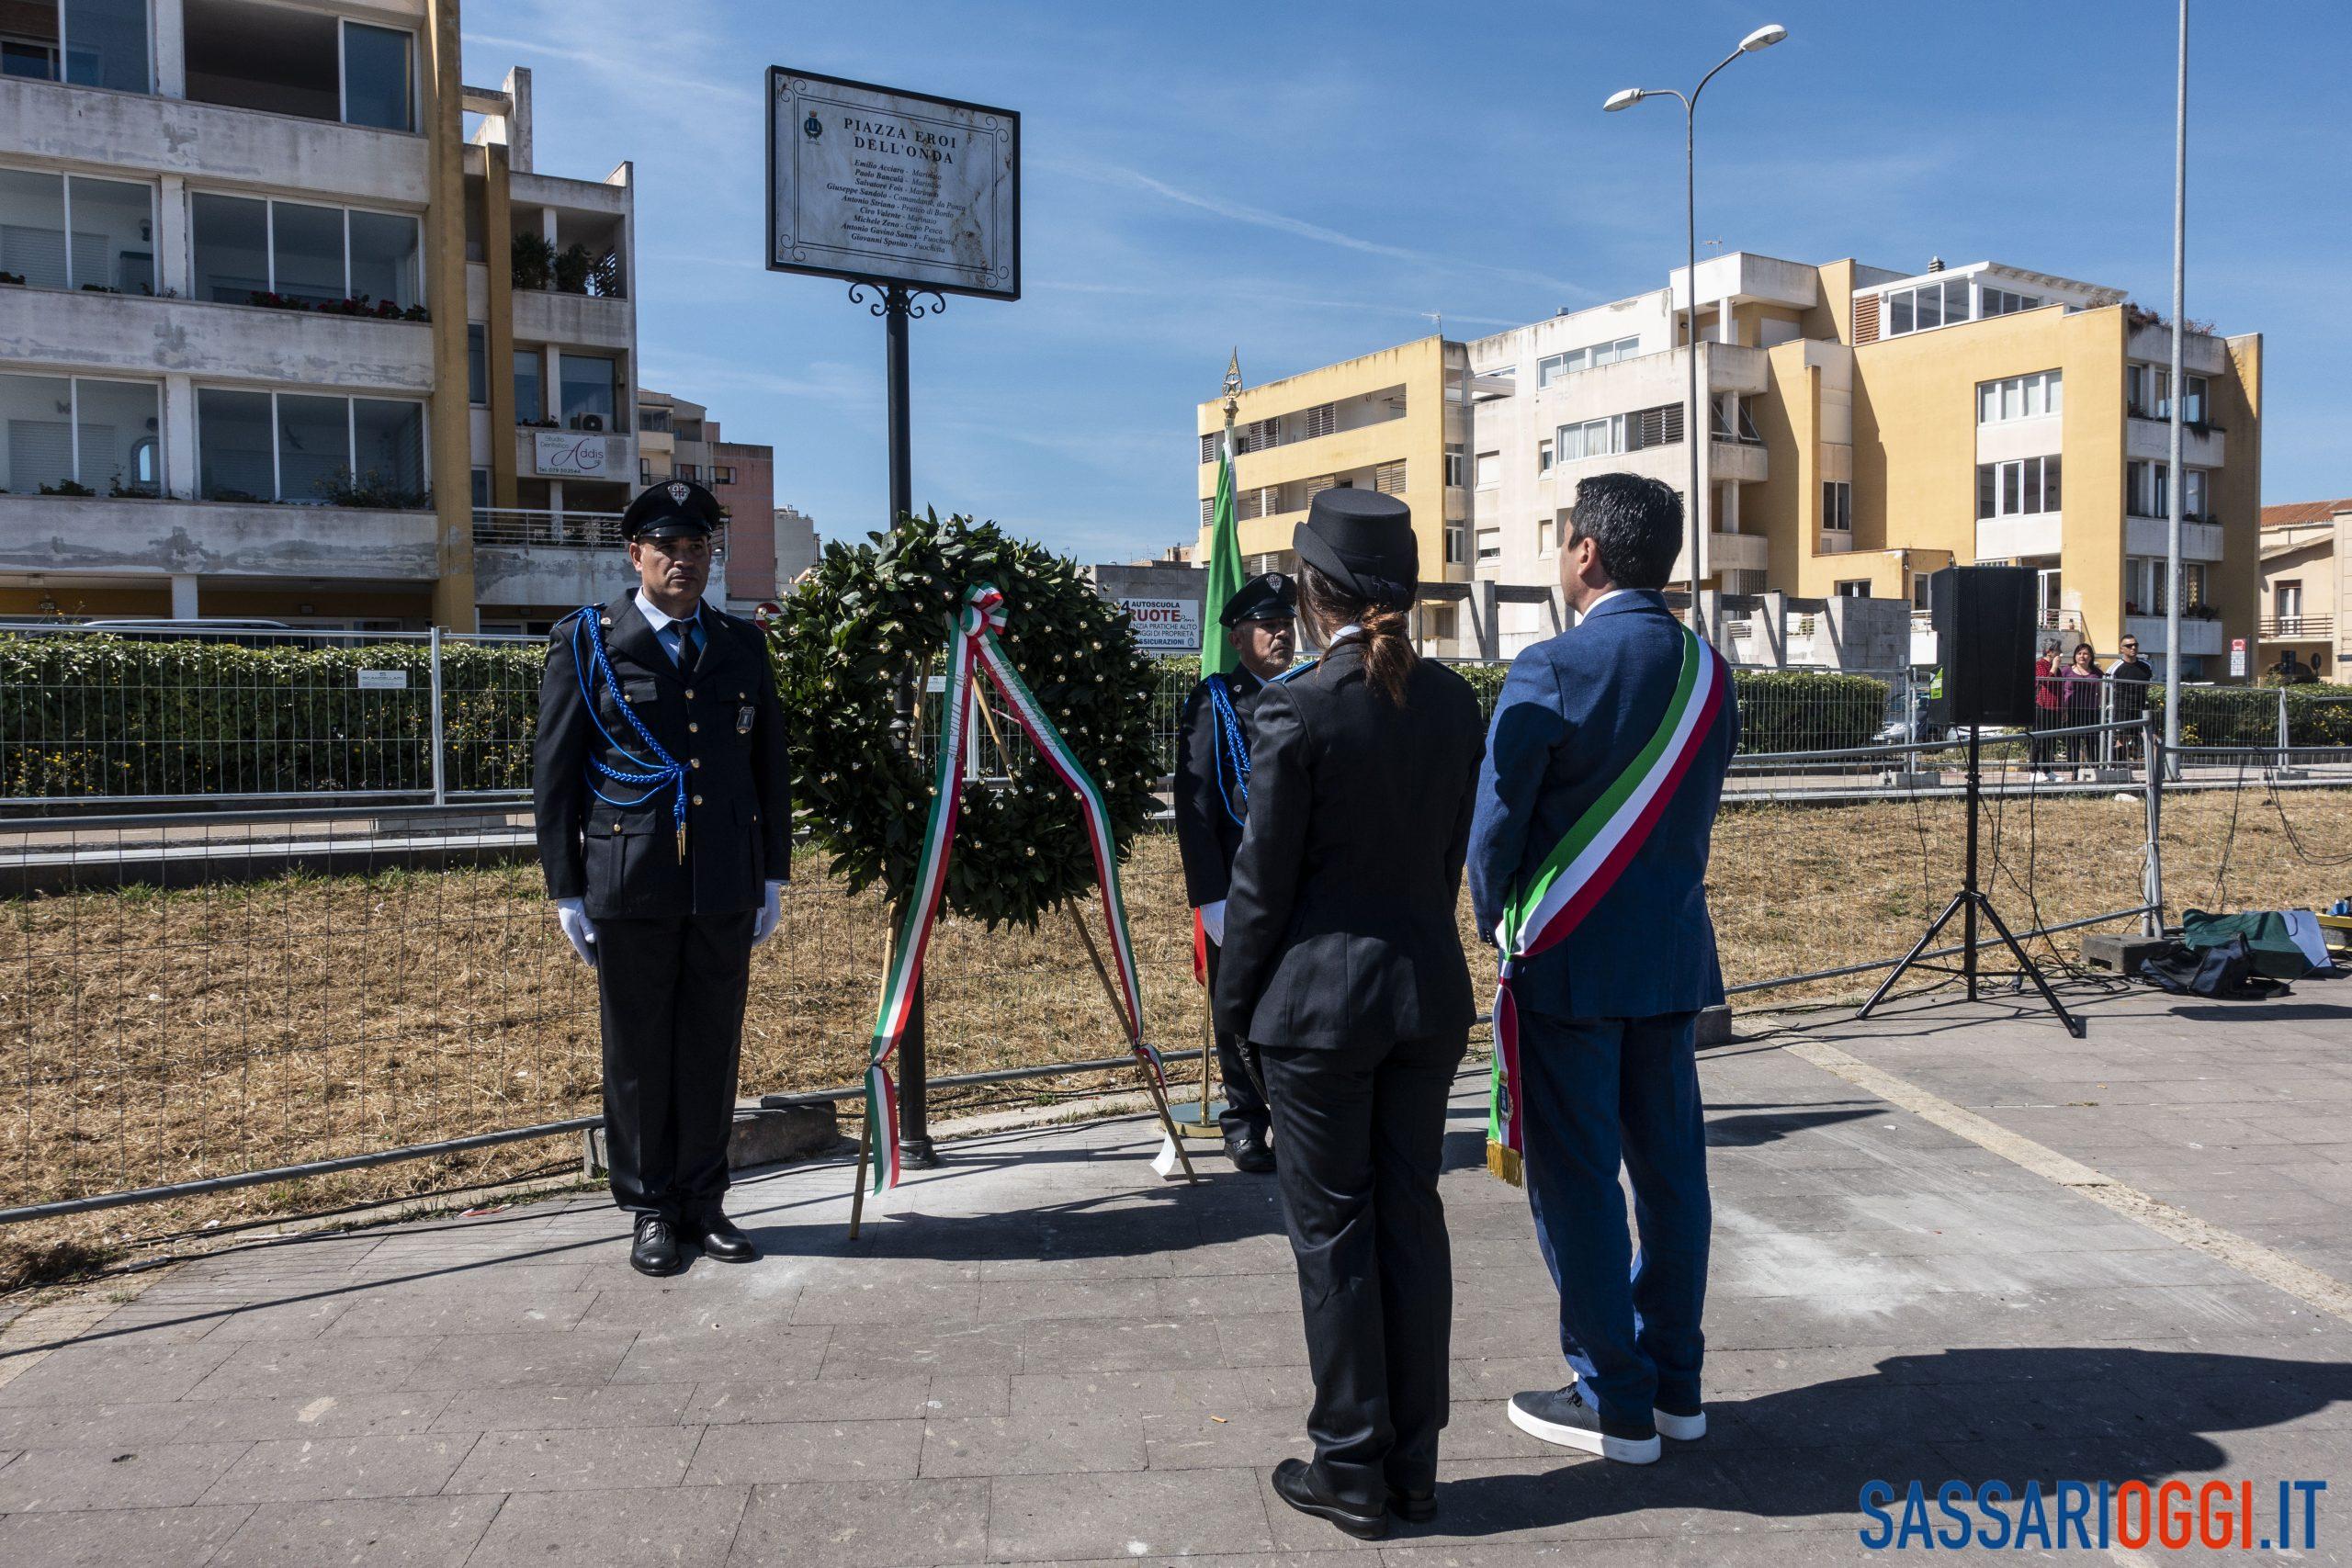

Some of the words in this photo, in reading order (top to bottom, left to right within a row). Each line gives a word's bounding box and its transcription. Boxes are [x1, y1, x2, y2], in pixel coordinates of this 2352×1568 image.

[844, 118, 906, 140] PIAZZA
[915, 130, 956, 149] EROI
[854, 136, 954, 164] DELL'ONDA
[854, 159, 877, 169] Emilio
[854, 168, 875, 178] Paolo
[827, 183, 858, 195] Giuseppe
[855, 177, 887, 189] Salvatore
[888, 184, 903, 192] Fois
[841, 195, 869, 205] Antonio
[870, 199, 896, 209] Striano
[934, 209, 955, 219] Bordo
[859, 207, 875, 215] Ciro
[876, 209, 901, 220] Valente
[908, 214, 937, 225] Marinaio
[841, 222, 869, 232] Antonio
[870, 227, 895, 236] Gavino
[895, 231, 918, 241] Sanna
[854, 214, 881, 225] Michele
[882, 219, 899, 228] Zeno
[905, 223, 922, 232] Capo
[924, 225, 944, 235] Pesca
[851, 233, 882, 244] Giovanni
[883, 237, 909, 248] Sposito
[914, 242, 945, 254] Fuochista
[1131, 601, 1181, 609] AUTOSCUOLA
[1128, 608, 1181, 623] RUOTE
[1138, 637, 1185, 646] SSICURAZIONI
